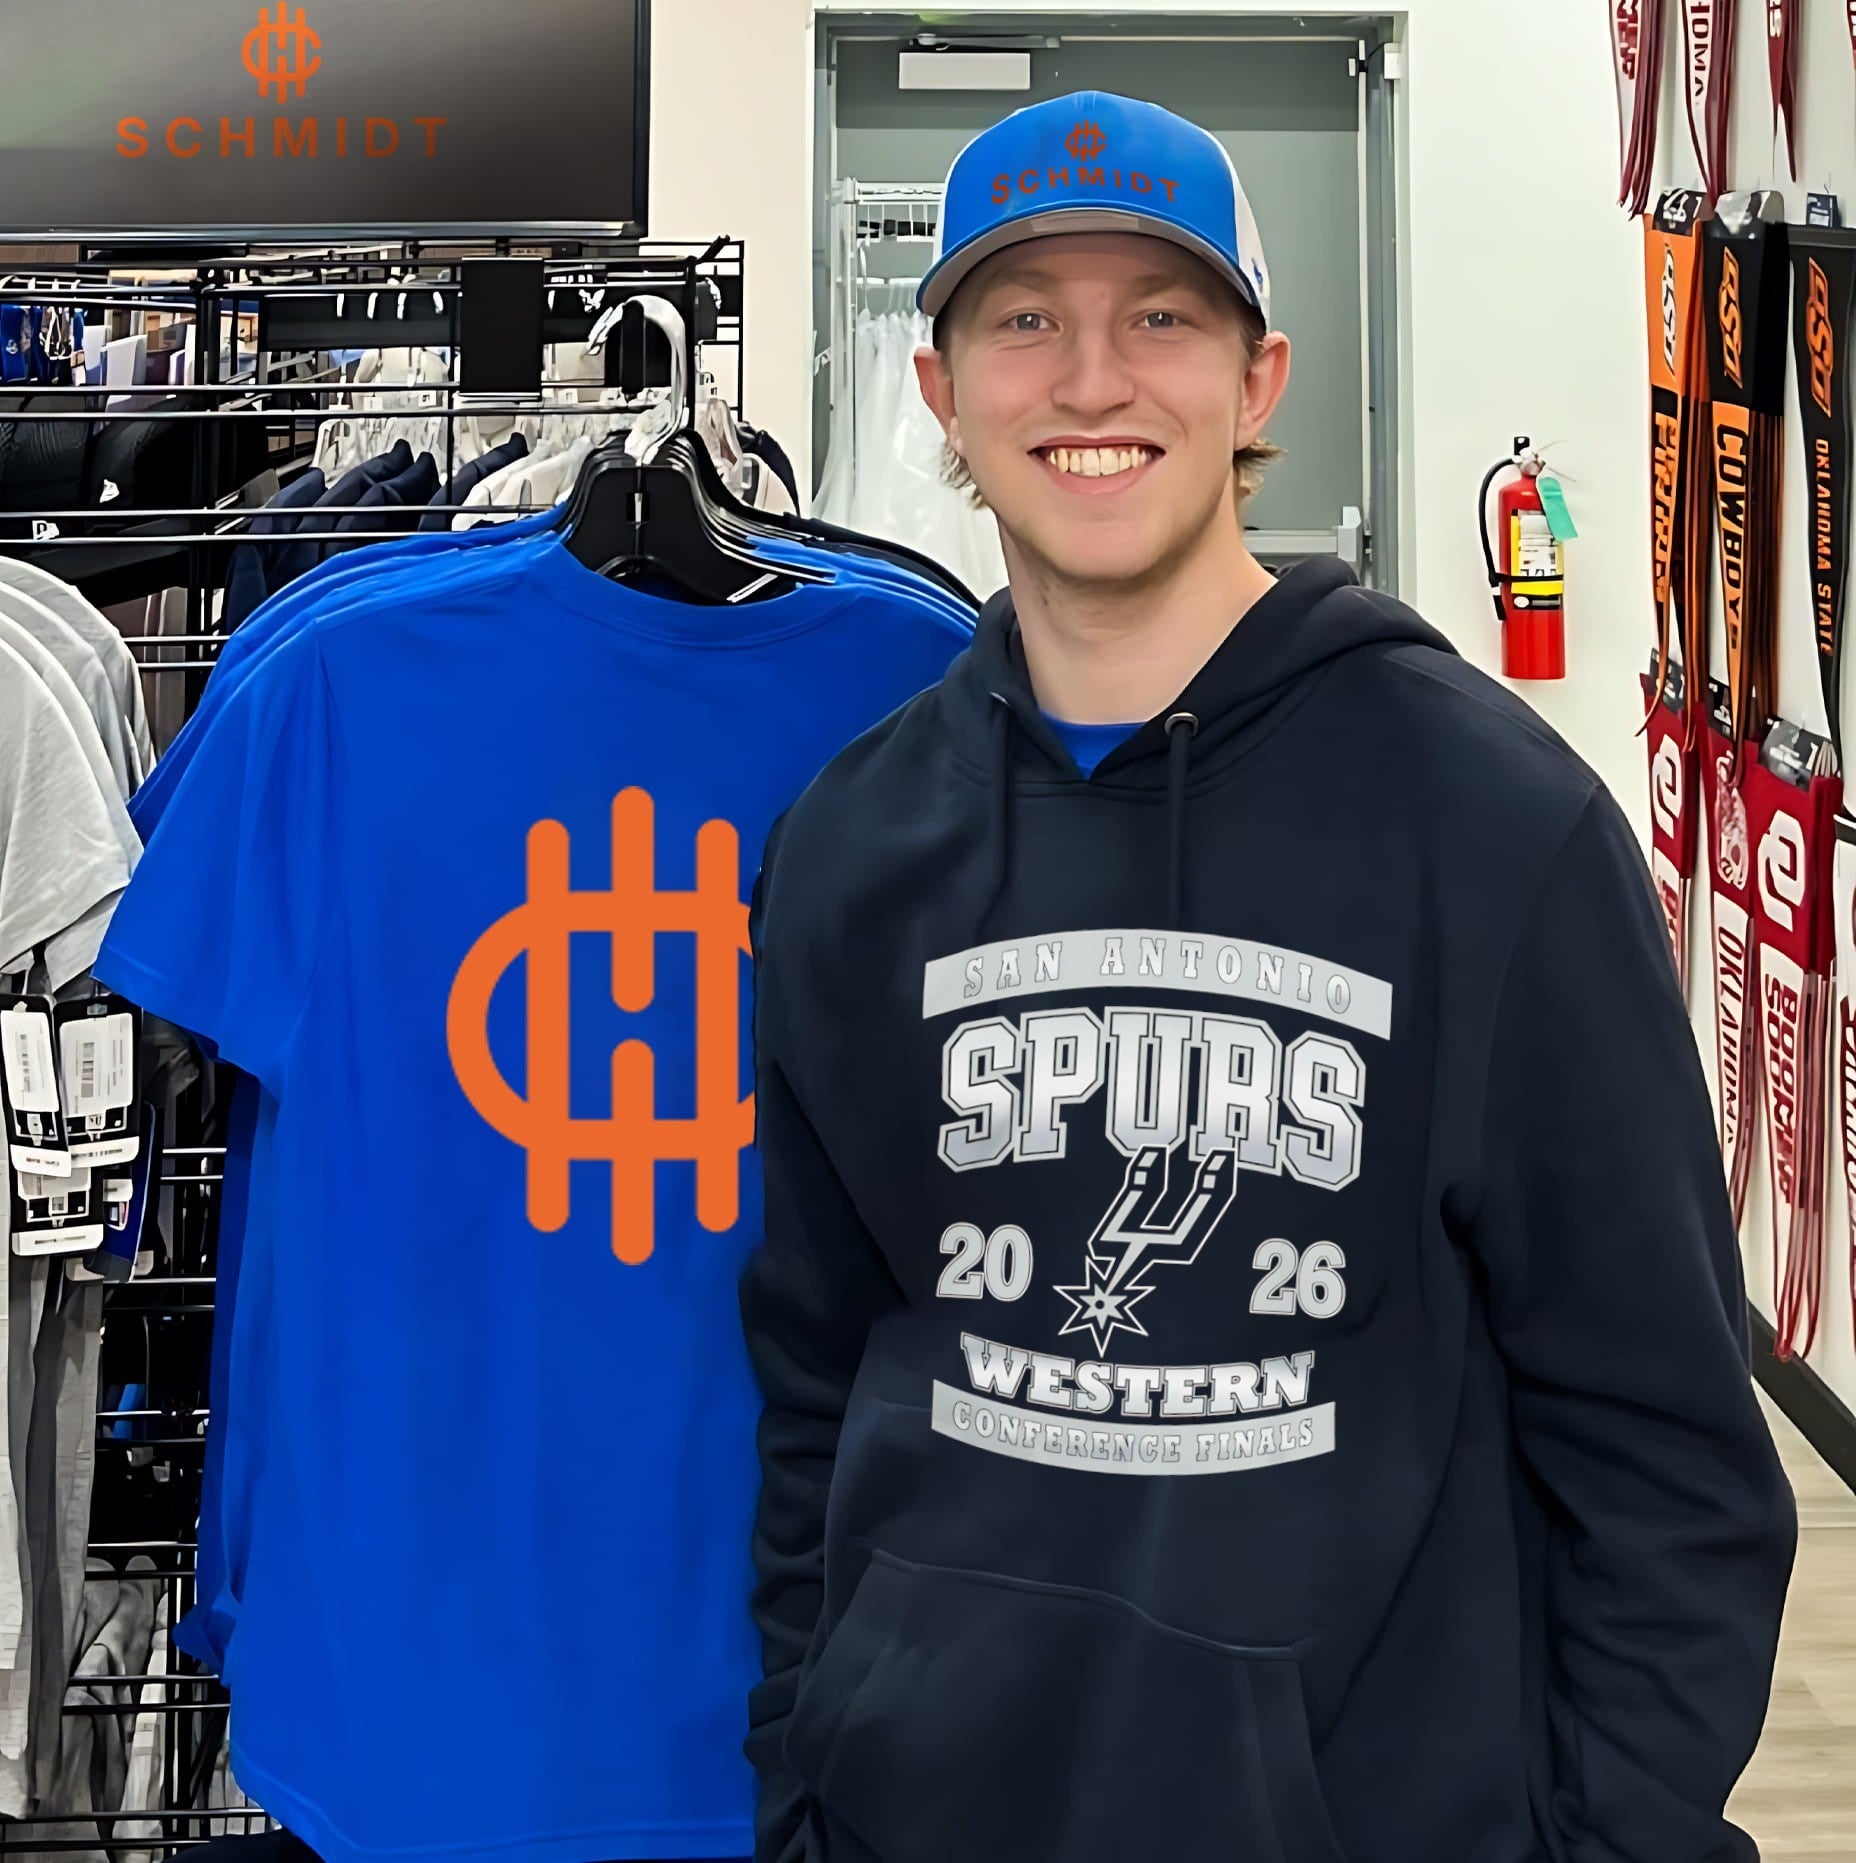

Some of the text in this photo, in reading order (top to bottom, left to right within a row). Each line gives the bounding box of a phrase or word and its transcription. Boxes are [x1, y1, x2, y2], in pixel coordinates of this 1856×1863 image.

[115, 116, 448, 159] SCHMIDT
[991, 166, 1179, 204] SCHMIDT
[1815, 438, 1832, 570] OKLAHOMA
[963, 937, 1352, 1014] SAN ANTONIO
[1718, 926, 1745, 1144] OKLAHOMA
[937, 1006, 1366, 1192] SPURS
[936, 1222, 1346, 1319] 20 26
[960, 1332, 1316, 1417] WESTERN
[952, 1401, 1314, 1464] CONFERENCE FINALS
